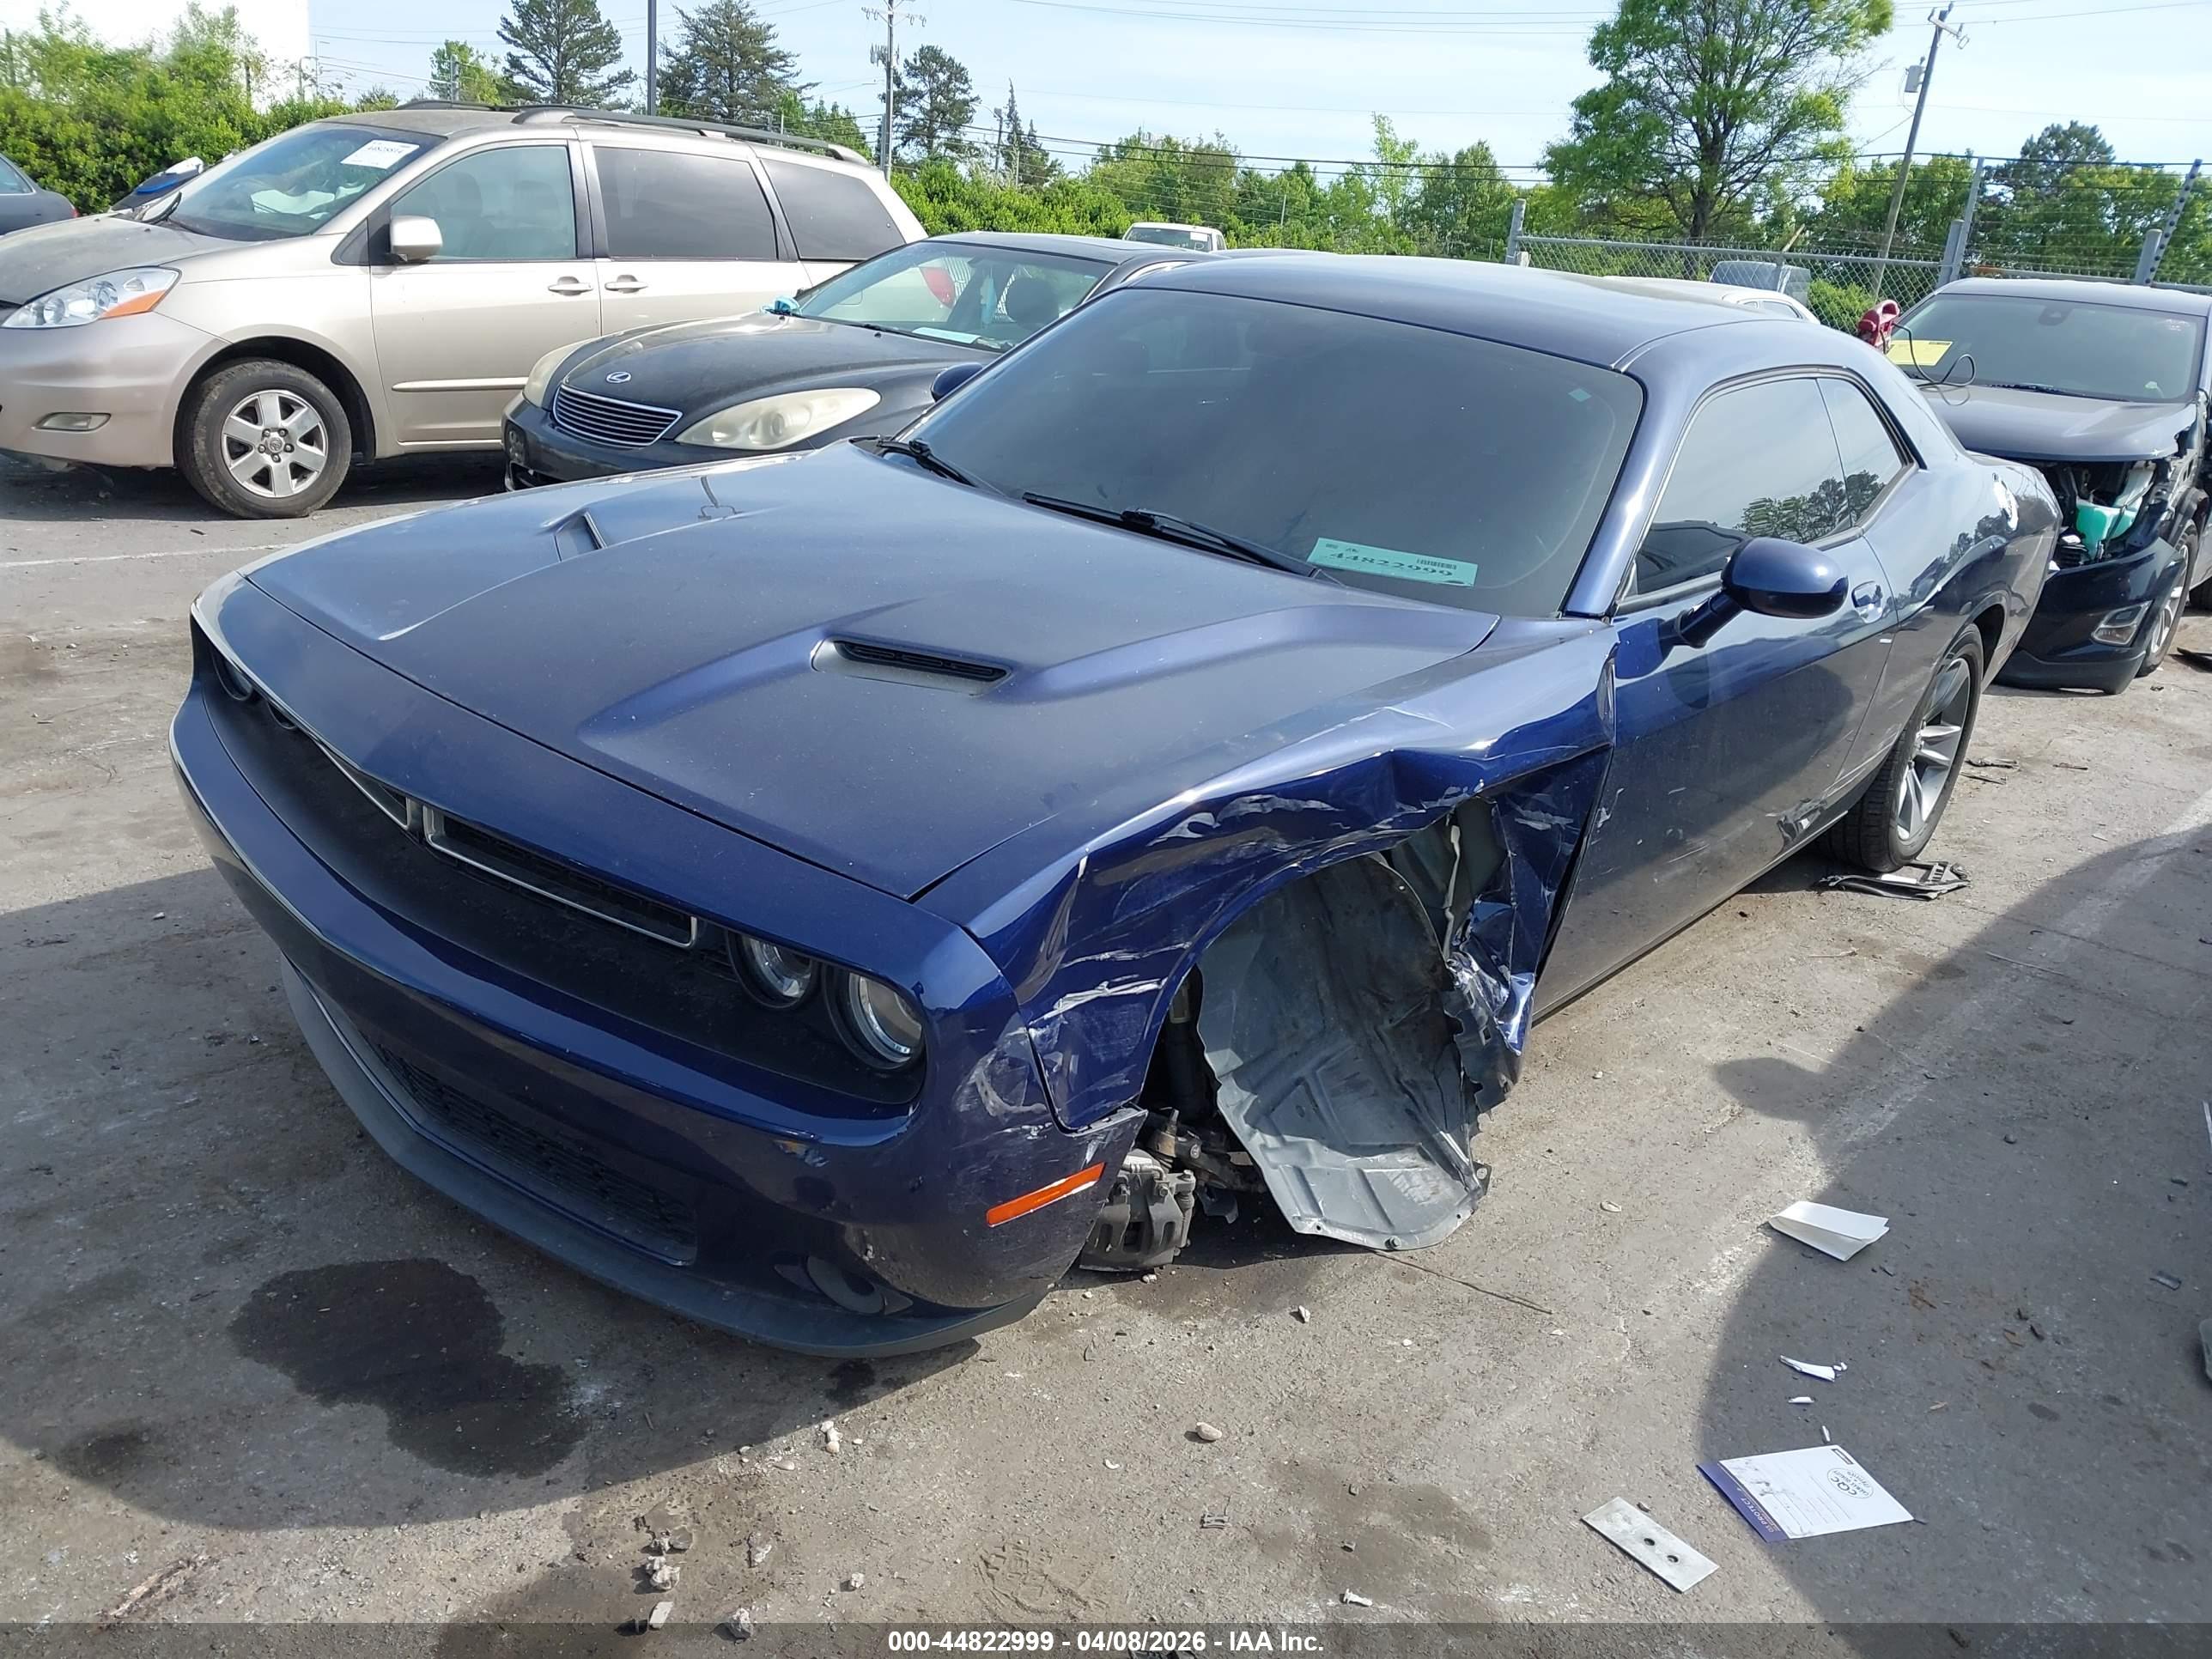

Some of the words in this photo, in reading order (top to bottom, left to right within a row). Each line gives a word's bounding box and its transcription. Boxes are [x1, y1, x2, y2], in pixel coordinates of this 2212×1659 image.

[1329, 552, 1453, 576] 44822999
[1831, 1477, 1857, 1495] CQC
[1741, 1498, 1767, 1526] PROTECT
